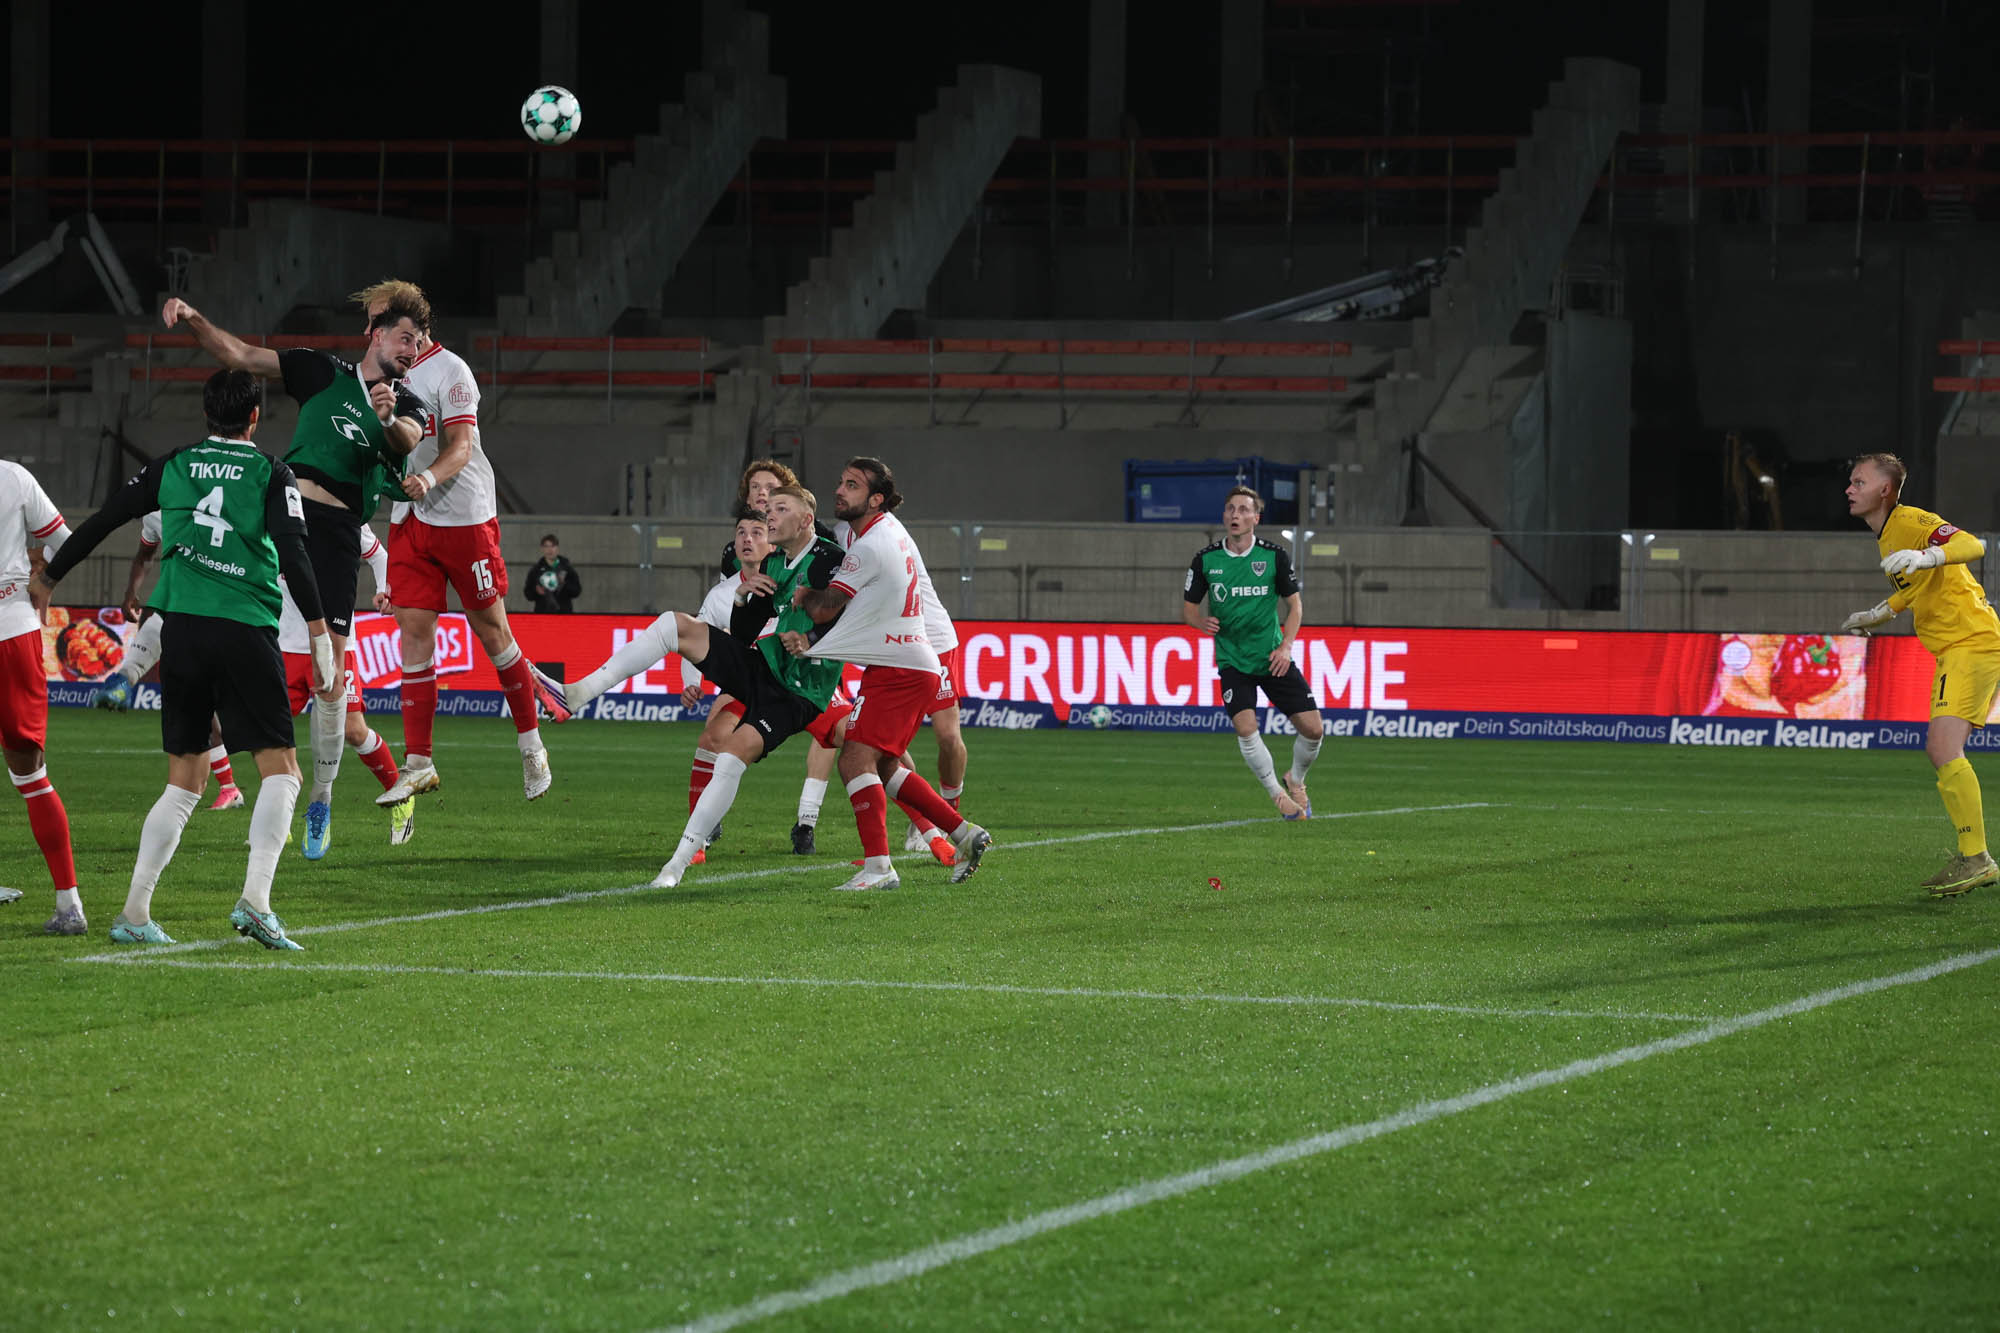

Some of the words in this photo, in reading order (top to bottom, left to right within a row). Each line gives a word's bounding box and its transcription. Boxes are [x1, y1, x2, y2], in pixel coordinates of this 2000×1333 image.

[342, 401, 363, 418] JAKO
[189, 462, 244, 480] TIKVIC
[193, 486, 233, 547] 4
[196, 552, 247, 577] Gieseke
[471, 558, 493, 591] 15
[901, 556, 924, 617] 2
[1231, 585, 1269, 597] FIEGE
[332, 617, 347, 627] JAKO
[1939, 673, 1947, 700] 1
[758, 718, 772, 733] JAKO
[1463, 717, 1504, 735] Dein
[1508, 718, 1667, 742] Sanitätskaufhaus
[1878, 727, 1921, 745] Dein
